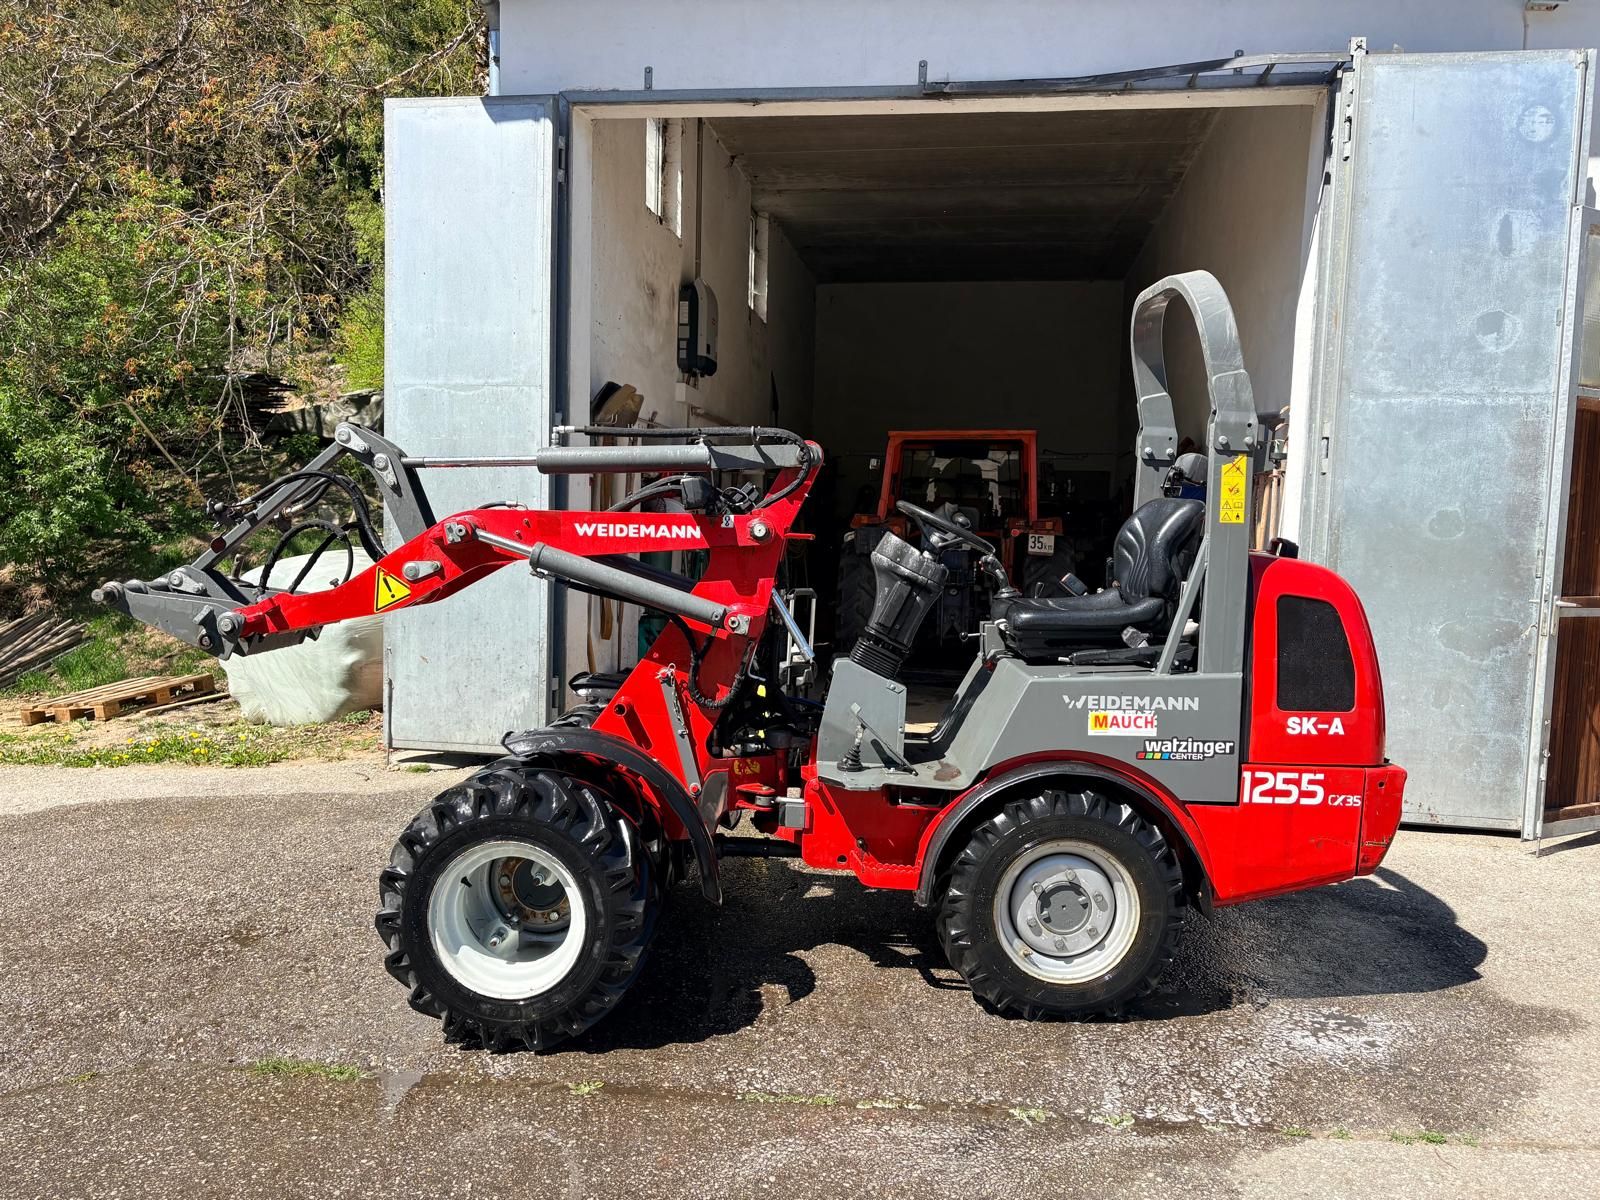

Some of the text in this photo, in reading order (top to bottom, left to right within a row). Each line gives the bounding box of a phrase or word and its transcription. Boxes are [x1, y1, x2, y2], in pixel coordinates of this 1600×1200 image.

[574, 523, 701, 539] WEIDEMANN
[1062, 695, 1199, 711] WEIDEMANN
[1094, 715, 1154, 729] MAUCH
[1286, 717, 1345, 735] SK-A
[1145, 737, 1234, 757] watzinger
[1170, 752, 1204, 761] CENTER
[1242, 771, 1362, 807] 1255 CX35
